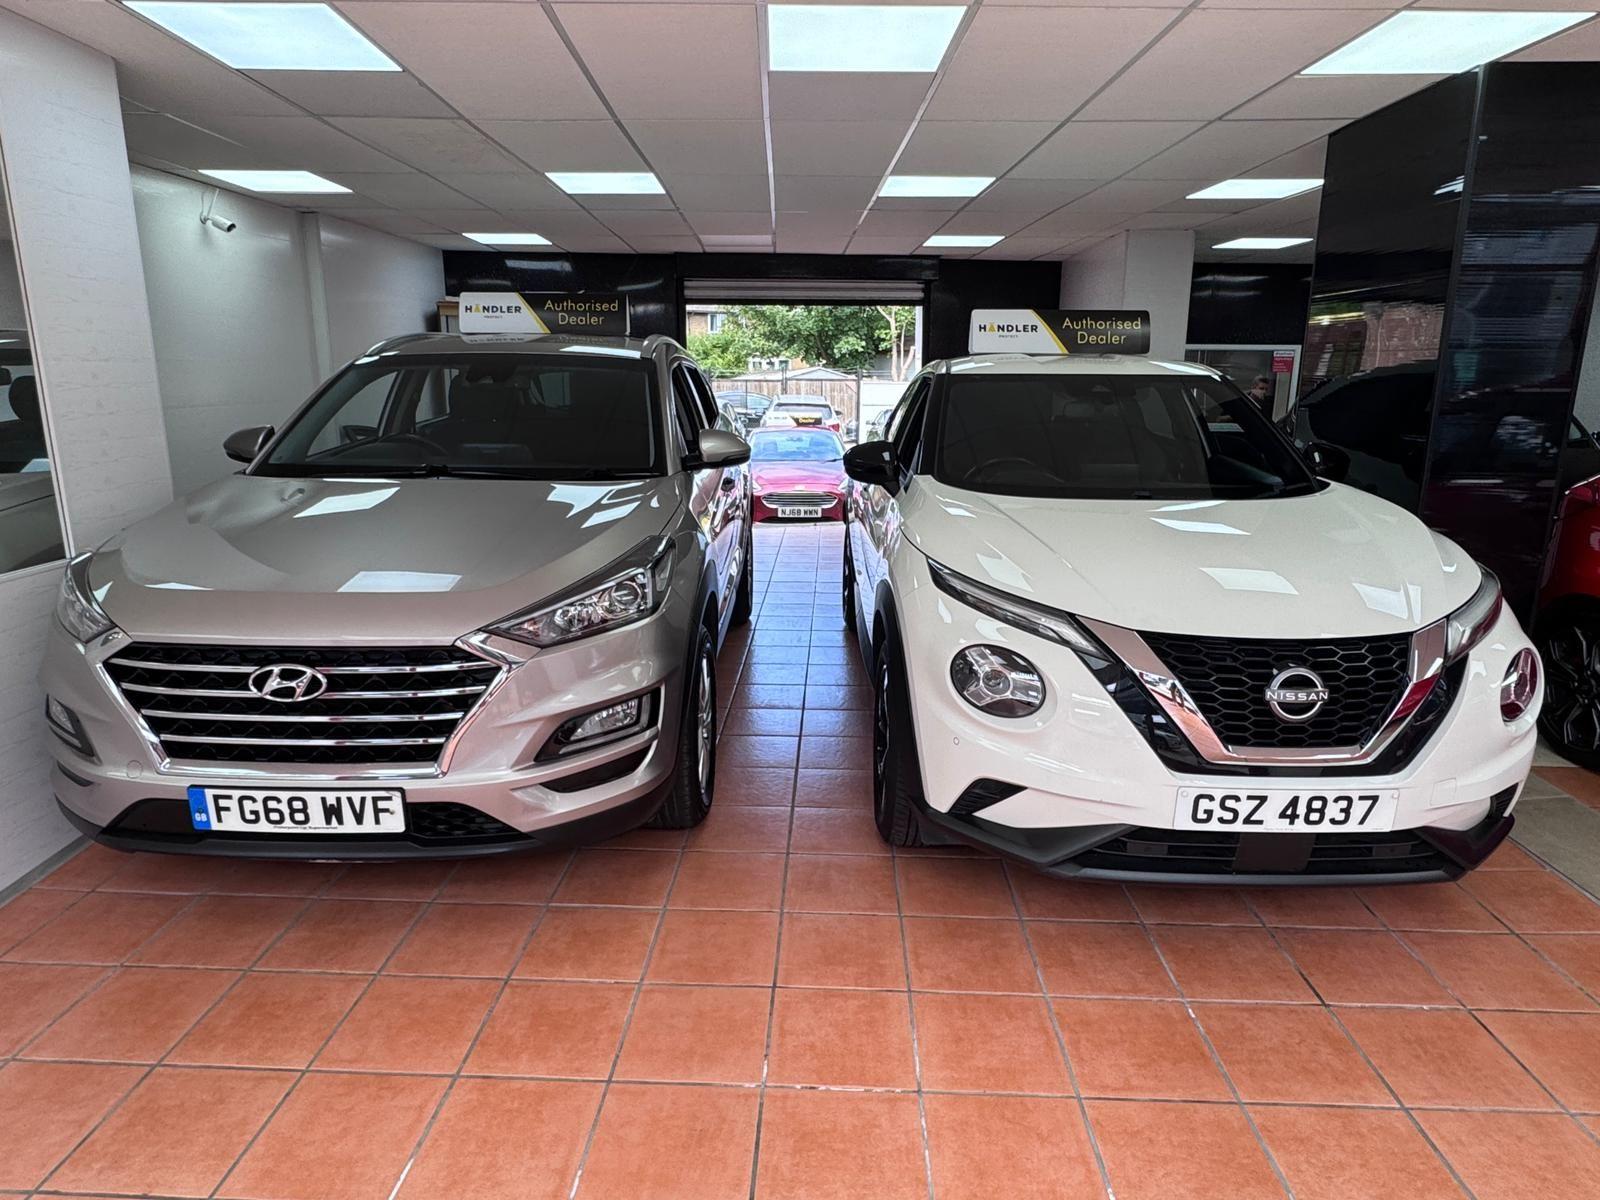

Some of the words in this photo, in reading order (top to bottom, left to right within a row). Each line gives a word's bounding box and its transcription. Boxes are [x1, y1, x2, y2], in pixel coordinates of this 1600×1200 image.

[544, 299, 619, 312] Authorised
[558, 313, 604, 326] Dealer
[1062, 317, 1142, 331] Authorised
[1077, 331, 1126, 345] Dealer
[1266, 691, 1328, 701] NISSAN
[212, 794, 311, 825] FG68
[321, 796, 394, 826] WVF
[1191, 793, 1269, 826] GSZ
[1278, 795, 1380, 826] 4837
[194, 812, 208, 822] GB
